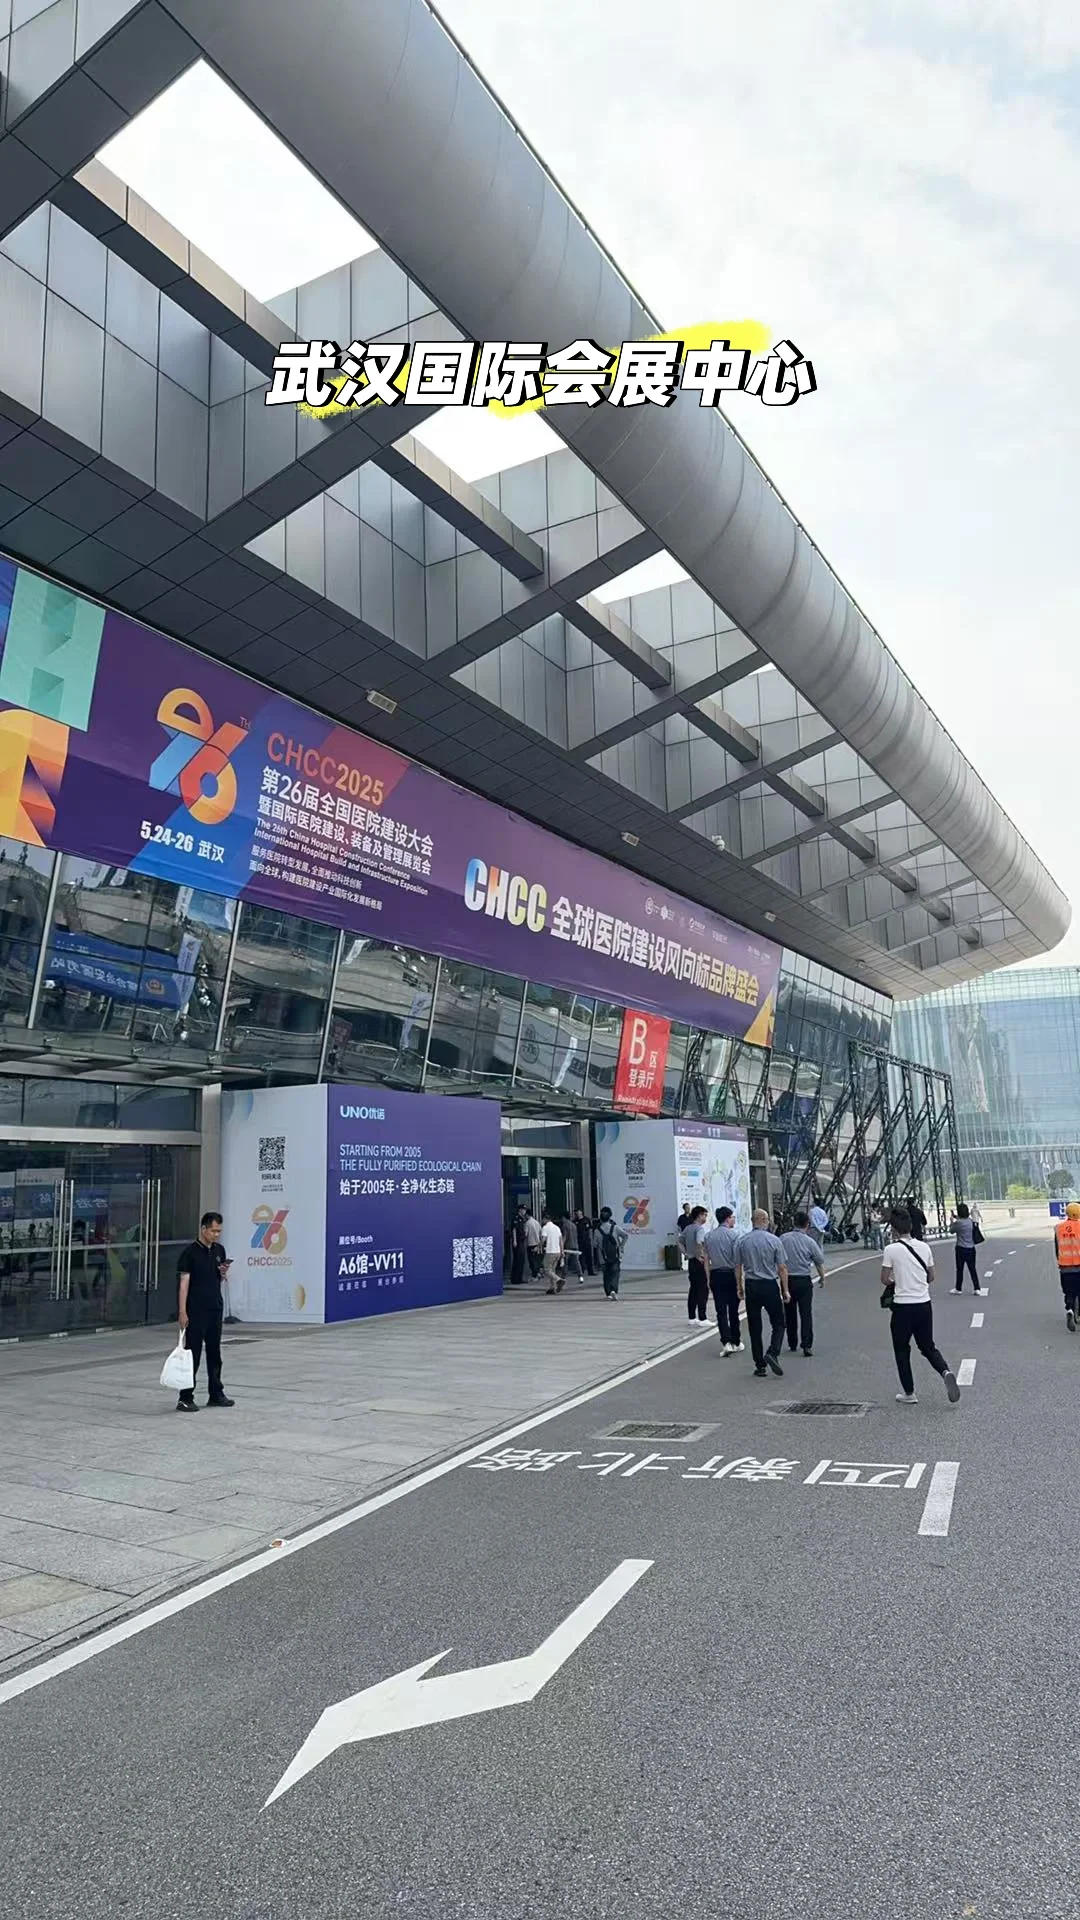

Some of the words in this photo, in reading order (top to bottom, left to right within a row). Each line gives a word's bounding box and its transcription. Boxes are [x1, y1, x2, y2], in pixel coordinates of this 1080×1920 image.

[267, 732, 385, 806] CHCC2025
[140, 820, 195, 853] 5.24-26
[197, 839, 226, 864] 武汉
[257, 794, 431, 876] 暨国际医院建设、装备及管理展览会
[260, 765, 434, 857] 第26届全国医院建设大会
[254, 828, 300, 851] International
[300, 844, 329, 863] Hospital
[329, 852, 347, 868] Build
[347, 859, 360, 873] and
[360, 864, 400, 887] Infrastructure
[400, 880, 429, 897] Exposition
[256, 818, 271, 831] The
[272, 822, 288, 837] 26th
[289, 830, 310, 843] China
[310, 836, 339, 853] Hospital
[339, 846, 378, 868] Construction
[378, 862, 411, 881] Conference
[463, 857, 547, 933] CHCC
[549, 895, 760, 1008] 全球医院建设风向标品牌盛会
[628, 1068, 655, 1090] 登录厅
[339, 1143, 380, 1157] STARTING
[380, 1145, 403, 1157] FROM
[404, 1146, 422, 1158] 2005
[340, 1159, 357, 1171] THE
[358, 1159, 382, 1171] FULLY
[383, 1160, 418, 1172] PURIFIED
[419, 1160, 461, 1173] ECOLOGICAL
[461, 1161, 482, 1173] CHAIN
[247, 1256, 293, 1267] CHCC2025
